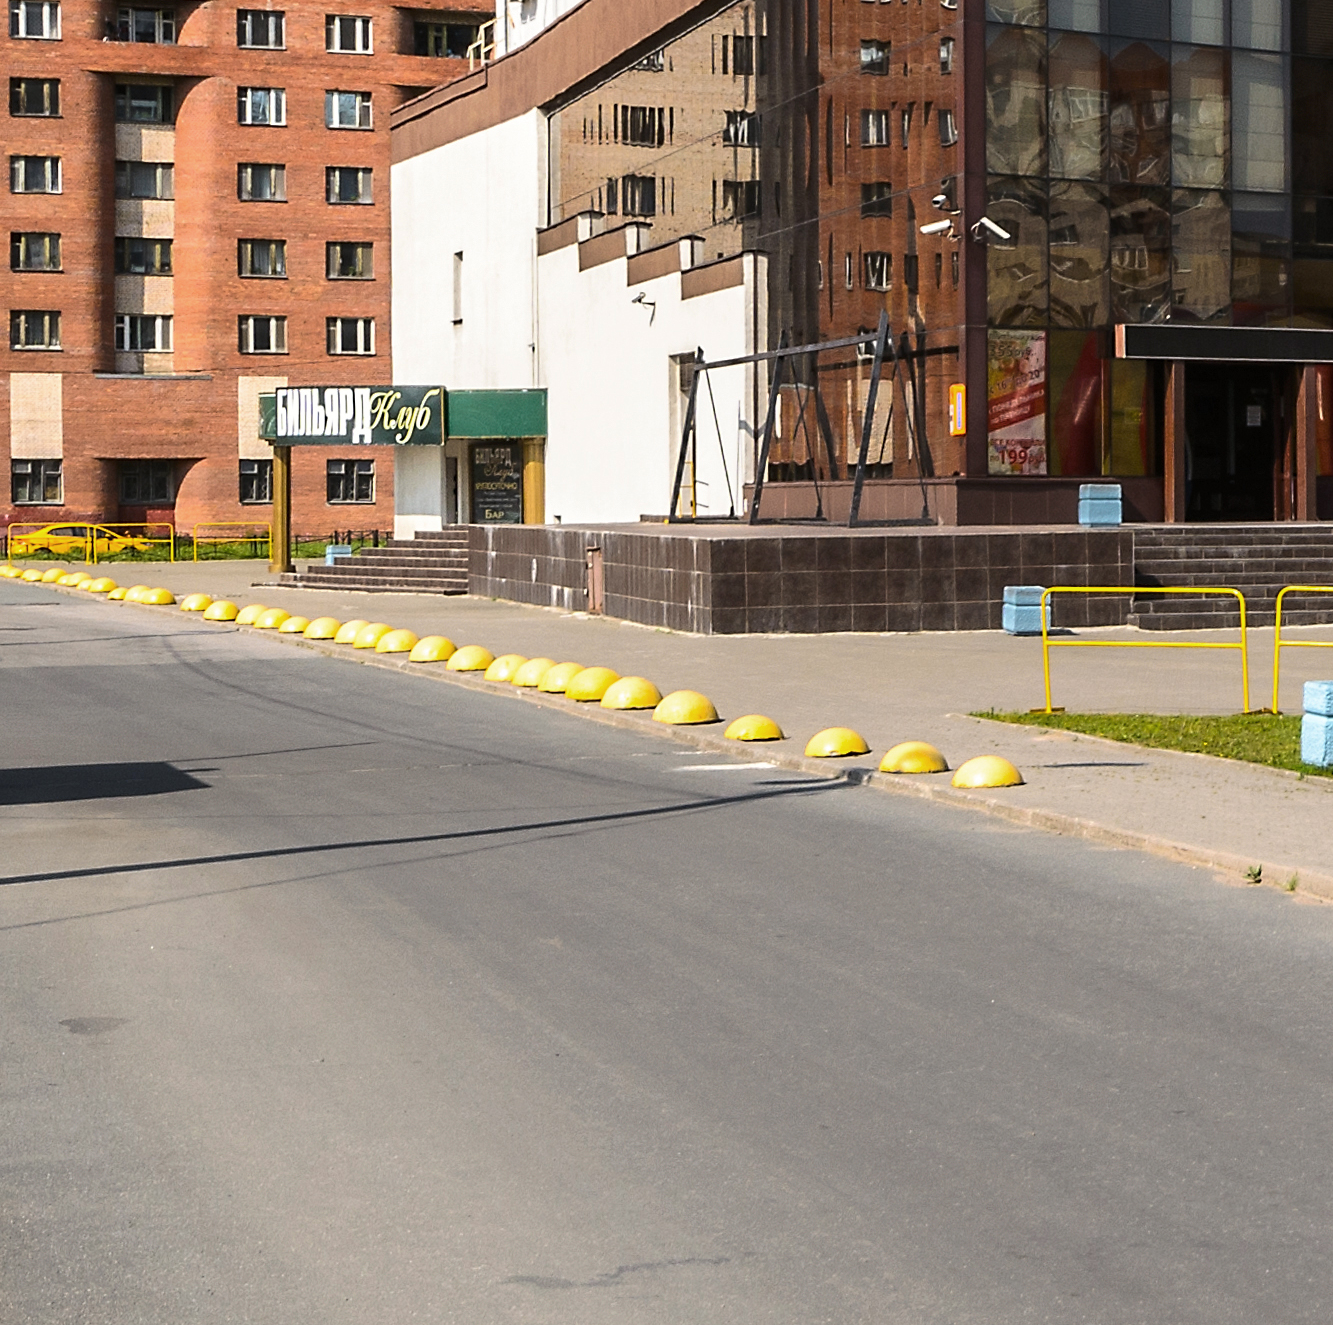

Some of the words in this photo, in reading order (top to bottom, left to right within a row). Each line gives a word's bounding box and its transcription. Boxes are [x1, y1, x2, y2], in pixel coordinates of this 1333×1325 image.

[276, 387, 373, 444] БИЛЬЯРД
[368, 388, 441, 444] Клуб
[1000, 449, 1029, 465] 199
